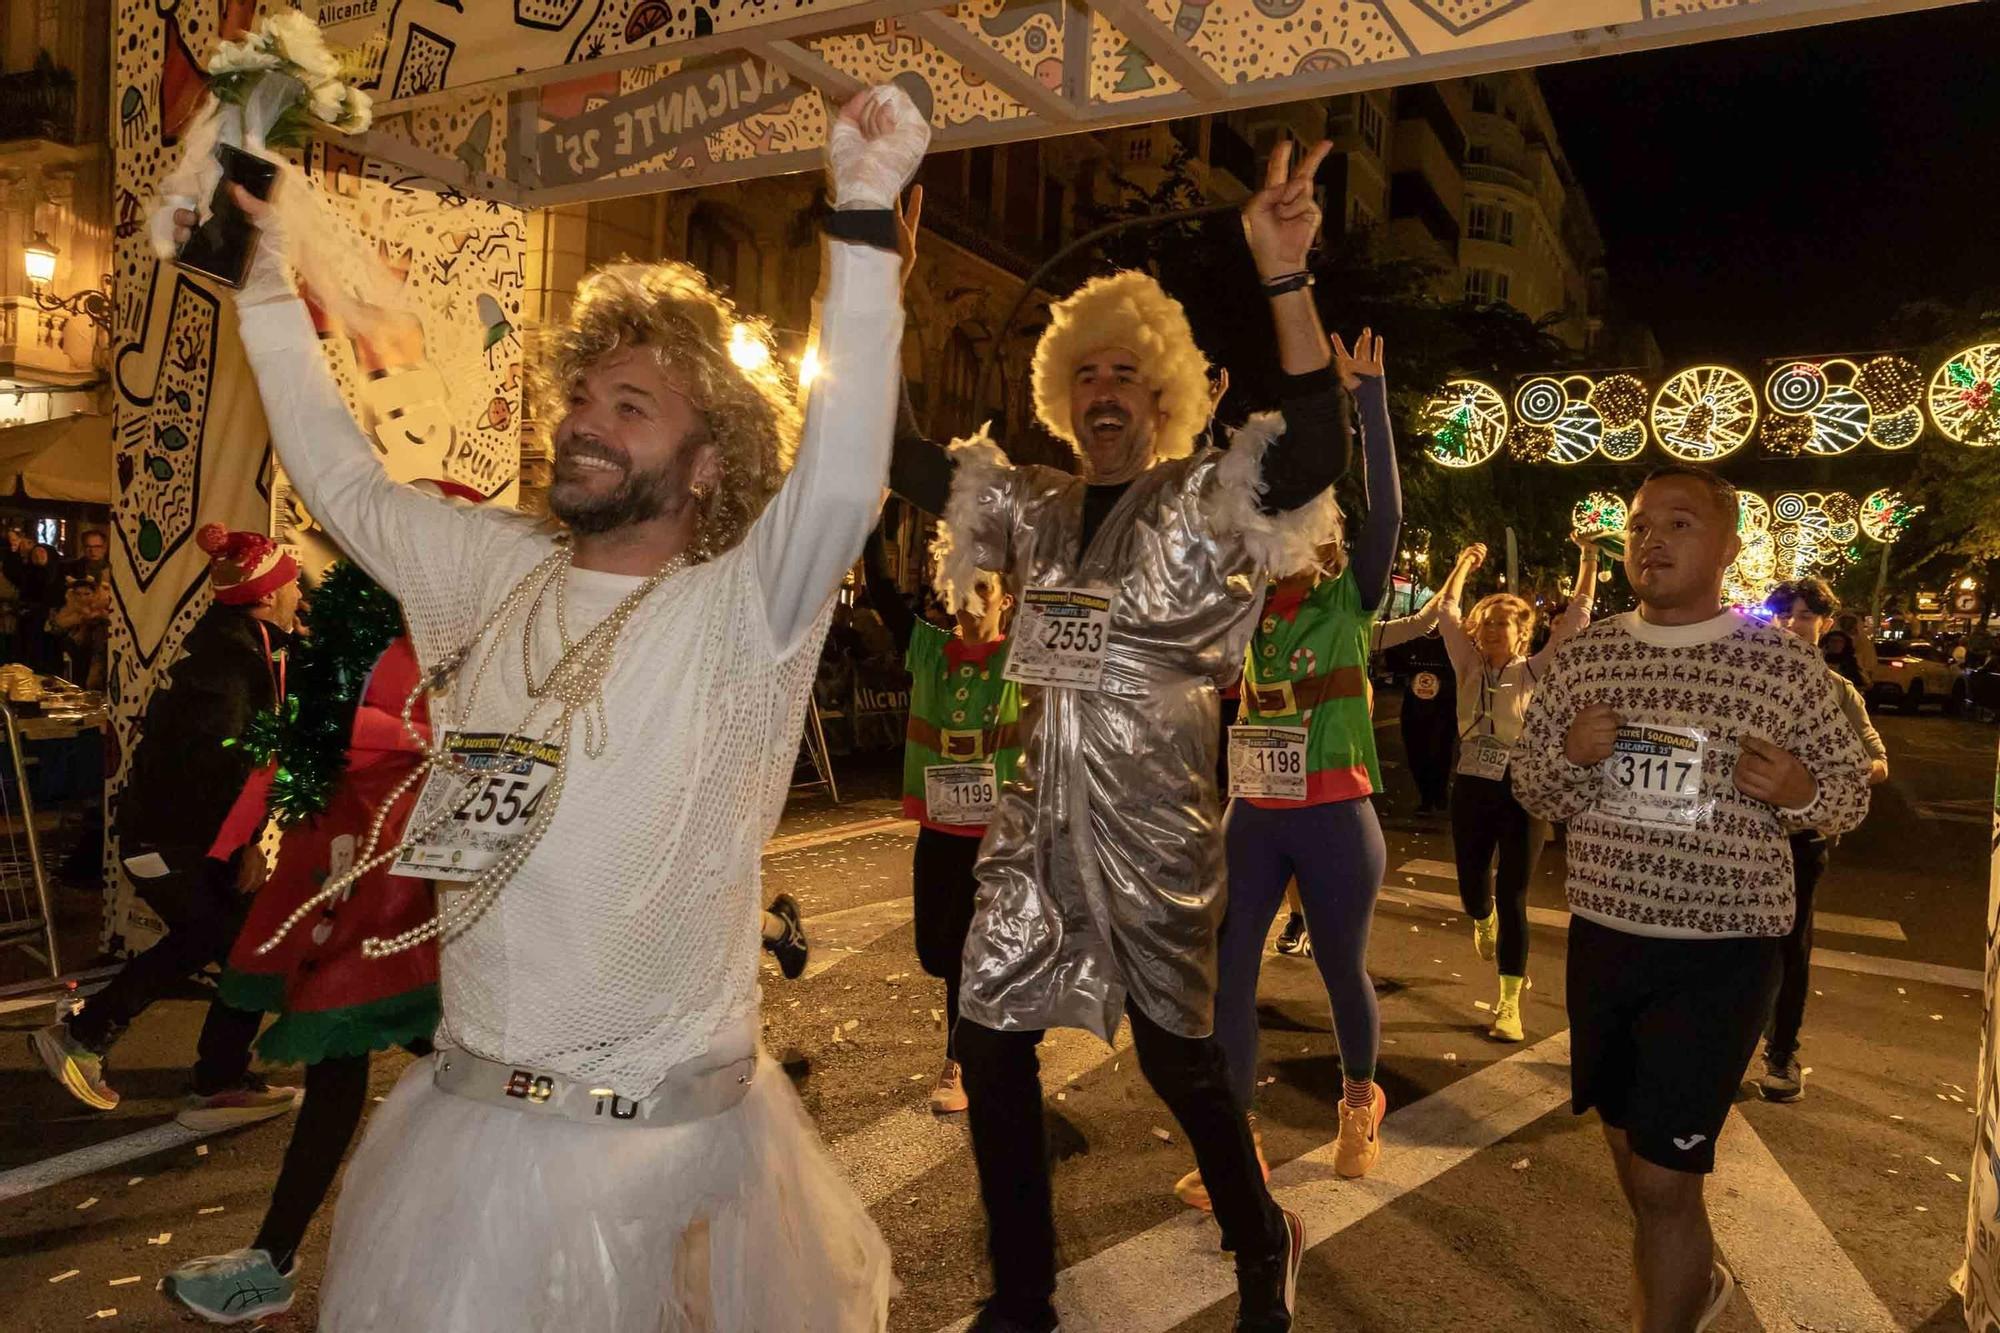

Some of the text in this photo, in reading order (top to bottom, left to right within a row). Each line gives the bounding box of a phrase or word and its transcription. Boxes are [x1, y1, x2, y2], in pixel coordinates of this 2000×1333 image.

[318, 0, 377, 25] Alicante
[1045, 620, 1103, 652] 2553
[1256, 749, 1301, 774] 1198
[1619, 756, 1693, 793] 3117
[453, 775, 548, 826] 2554
[952, 783, 993, 804] 1199
